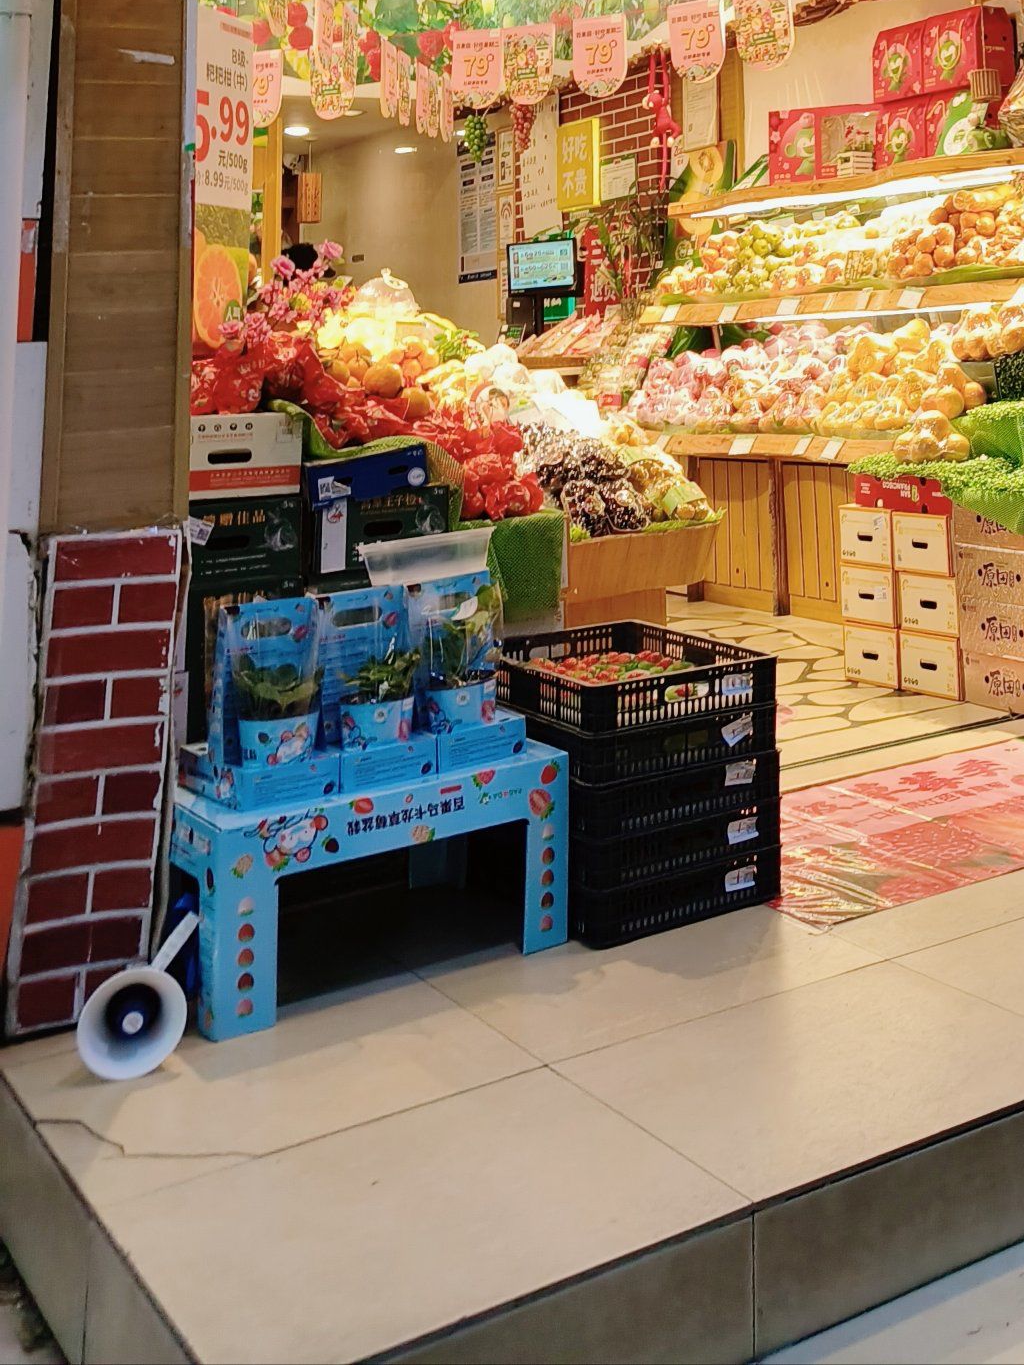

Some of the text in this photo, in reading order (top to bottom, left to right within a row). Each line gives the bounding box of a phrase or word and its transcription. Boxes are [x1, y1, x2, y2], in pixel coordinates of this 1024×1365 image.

[194, 89, 250, 162] 5.99
[218, 149, 248, 173] 元/500g
[561, 135, 588, 165] 好吃
[561, 169, 588, 199] 不贵
